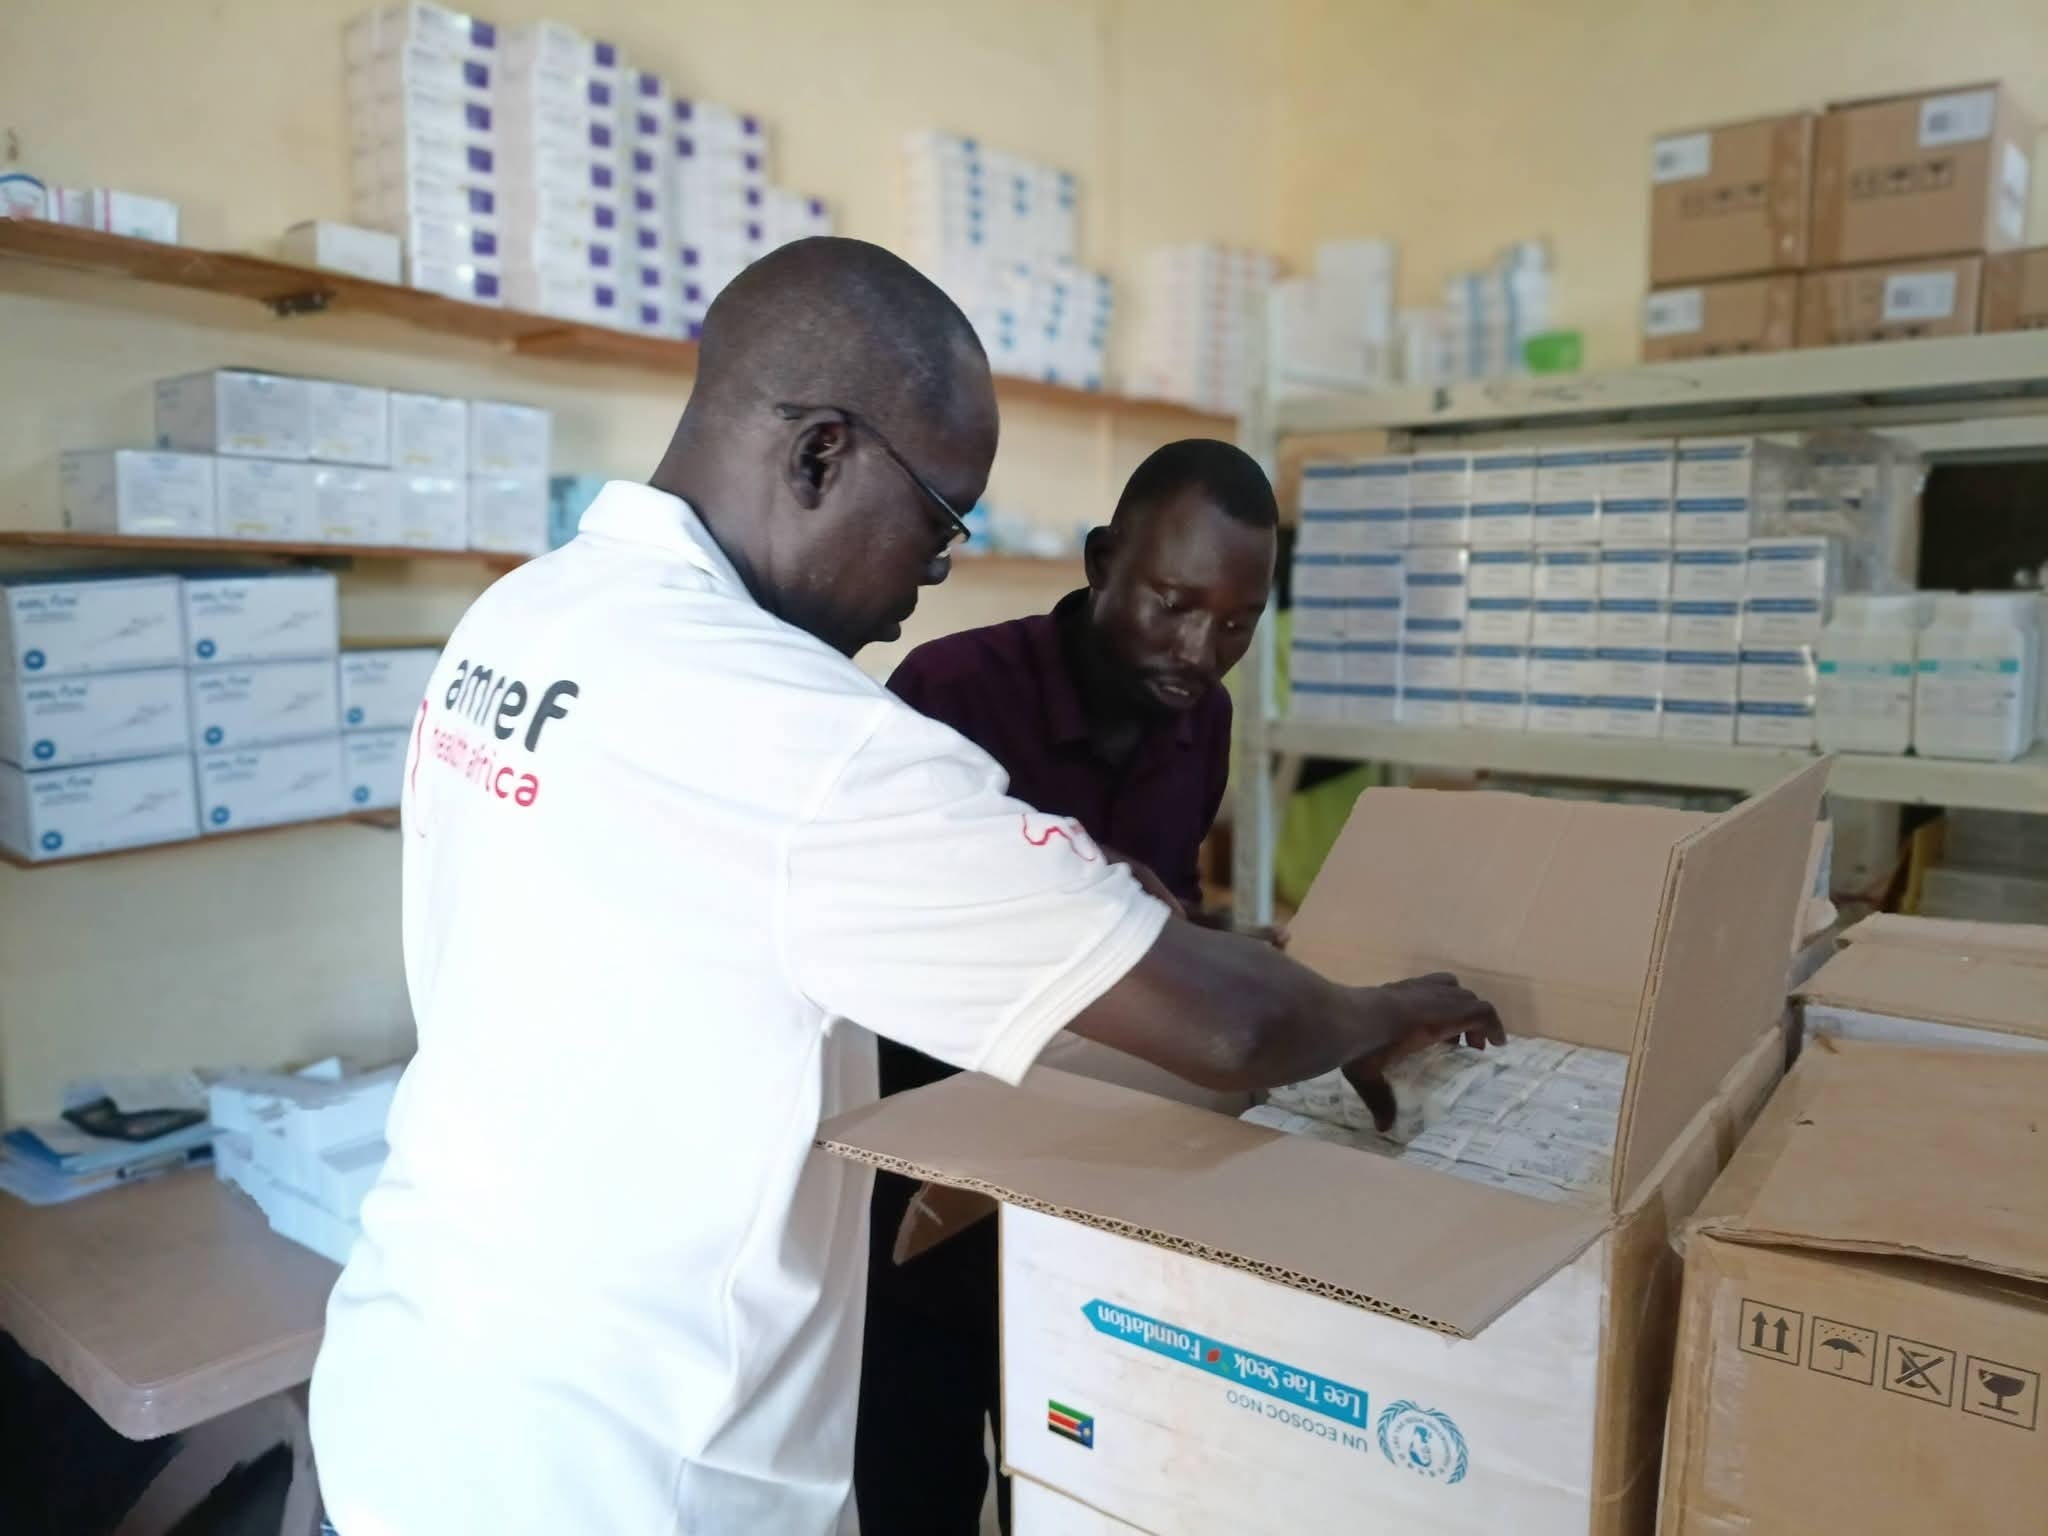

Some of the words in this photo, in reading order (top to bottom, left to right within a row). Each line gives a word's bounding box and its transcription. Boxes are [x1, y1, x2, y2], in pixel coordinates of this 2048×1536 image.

[446, 659, 579, 752] amref
[1097, 1304, 1201, 1361] Foundation
[1233, 1352, 1280, 1390] Seok
[1281, 1370, 1319, 1405] Tae
[1225, 1388, 1263, 1415] NGO
[1322, 1385, 1361, 1419] Lee
[1266, 1403, 1338, 1442] ECOSOC
[1342, 1430, 1369, 1453] UN
